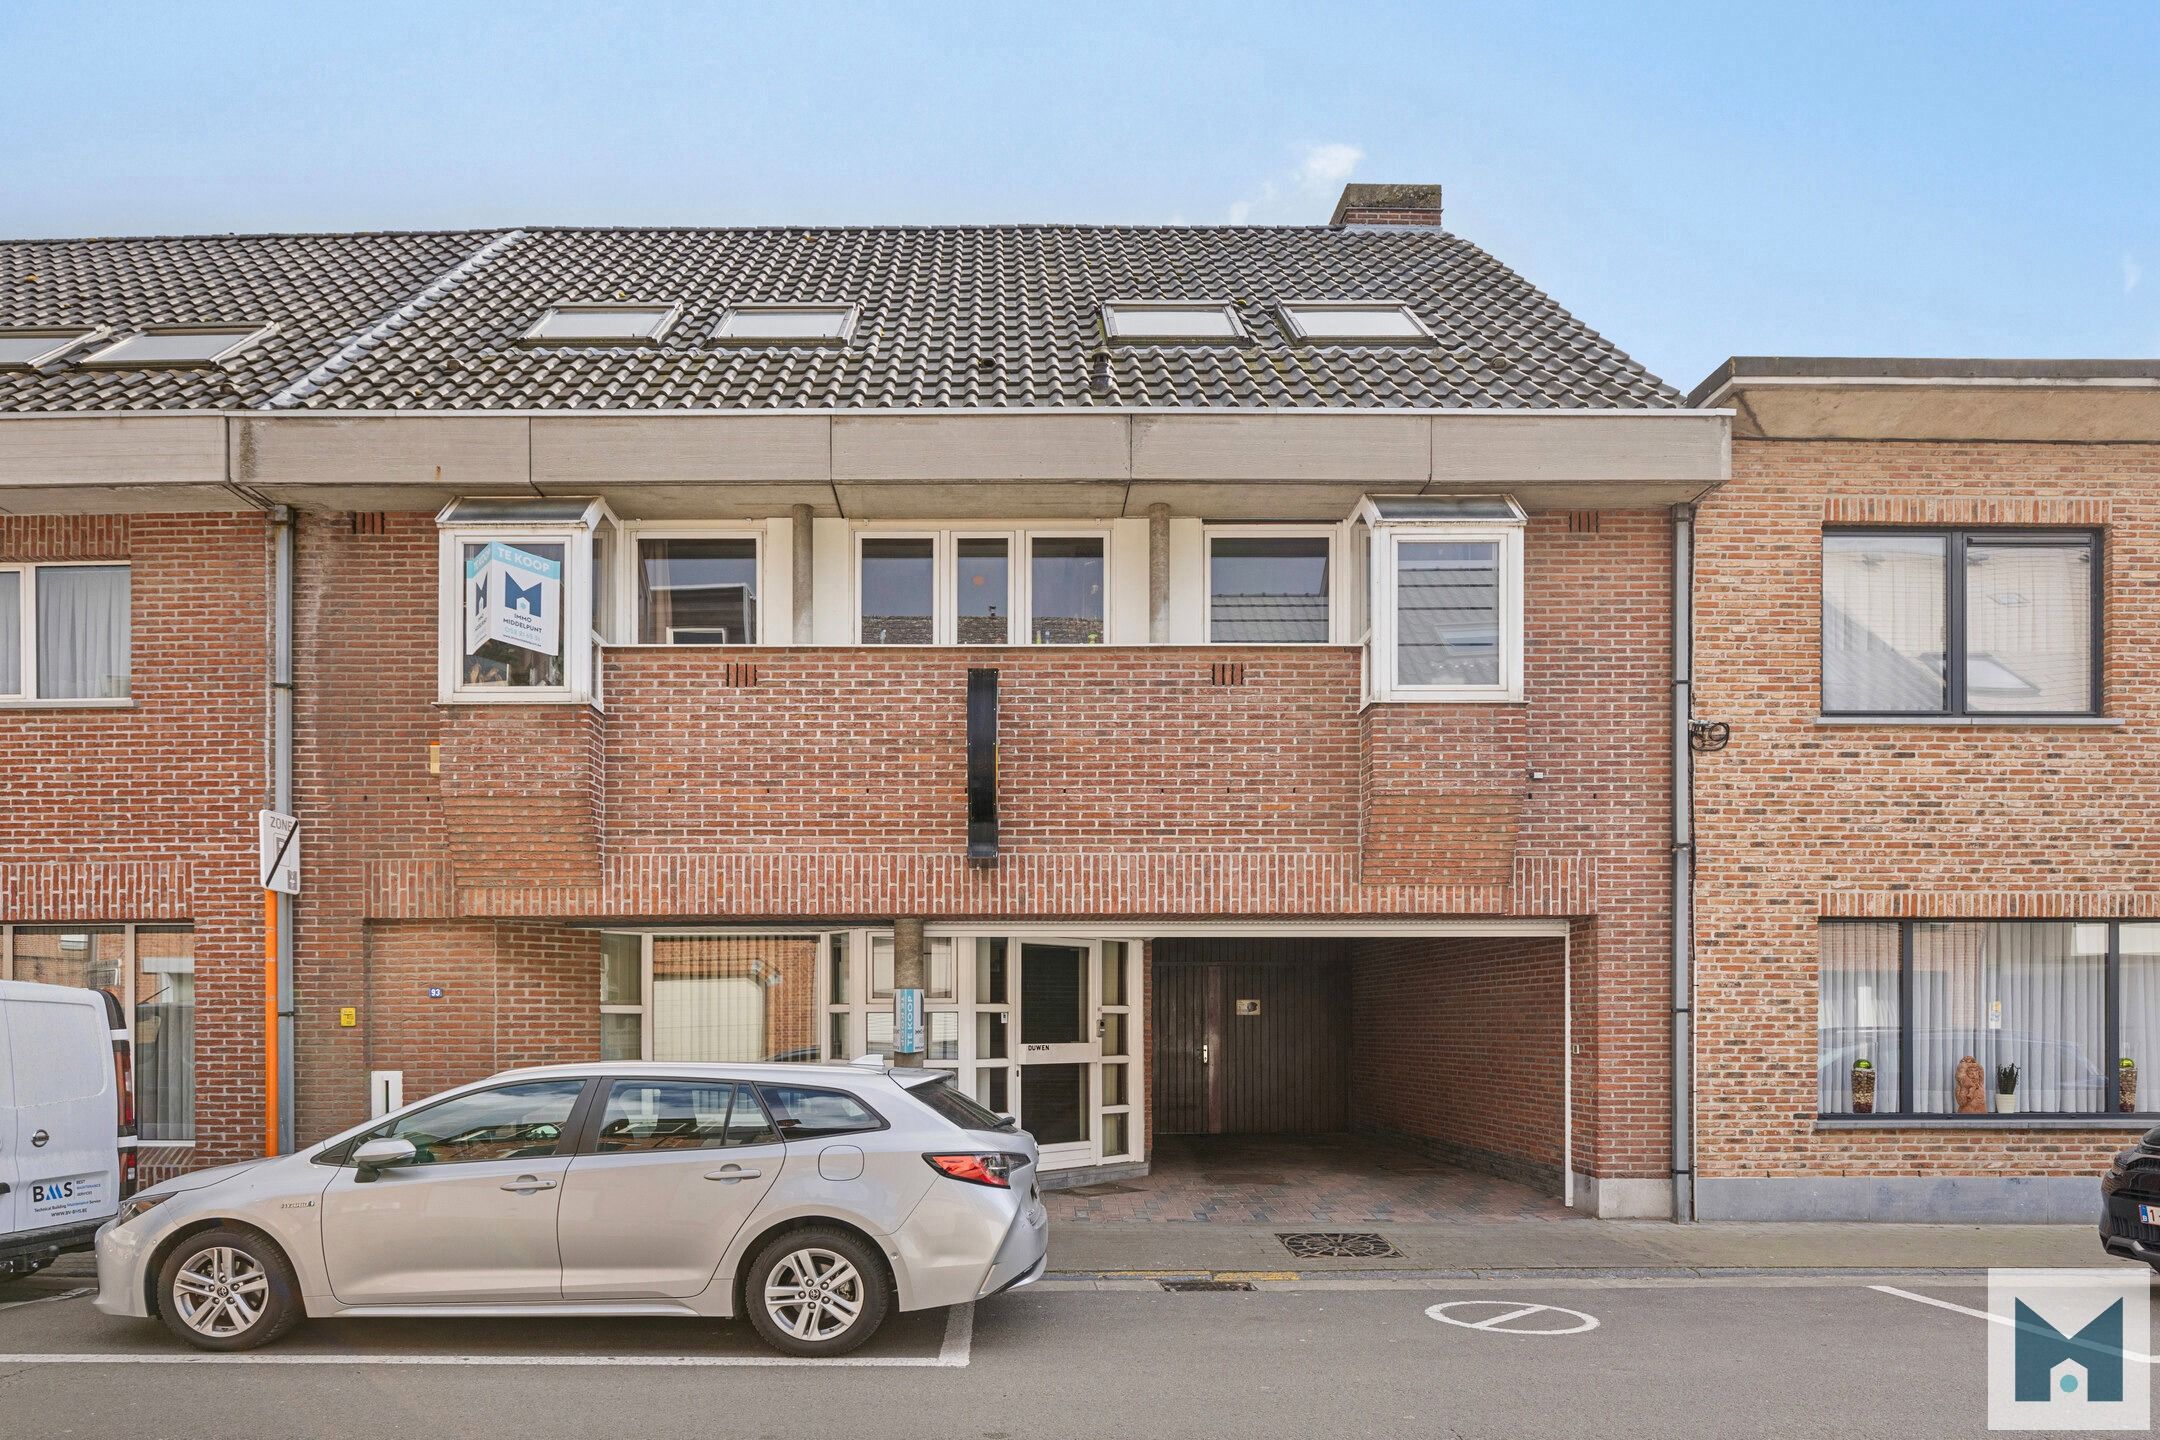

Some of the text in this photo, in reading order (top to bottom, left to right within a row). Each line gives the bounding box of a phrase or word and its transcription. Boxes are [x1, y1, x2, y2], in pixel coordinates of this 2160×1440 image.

[498, 547, 550, 573] TE KOOP
[503, 618, 542, 633] MIDDELPUNT
[514, 613, 532, 623] IMMO
[270, 816, 292, 832] ZONE
[431, 988, 440, 997] 93
[907, 1033, 913, 1047] TE
[33, 1182, 73, 1203] BMS
